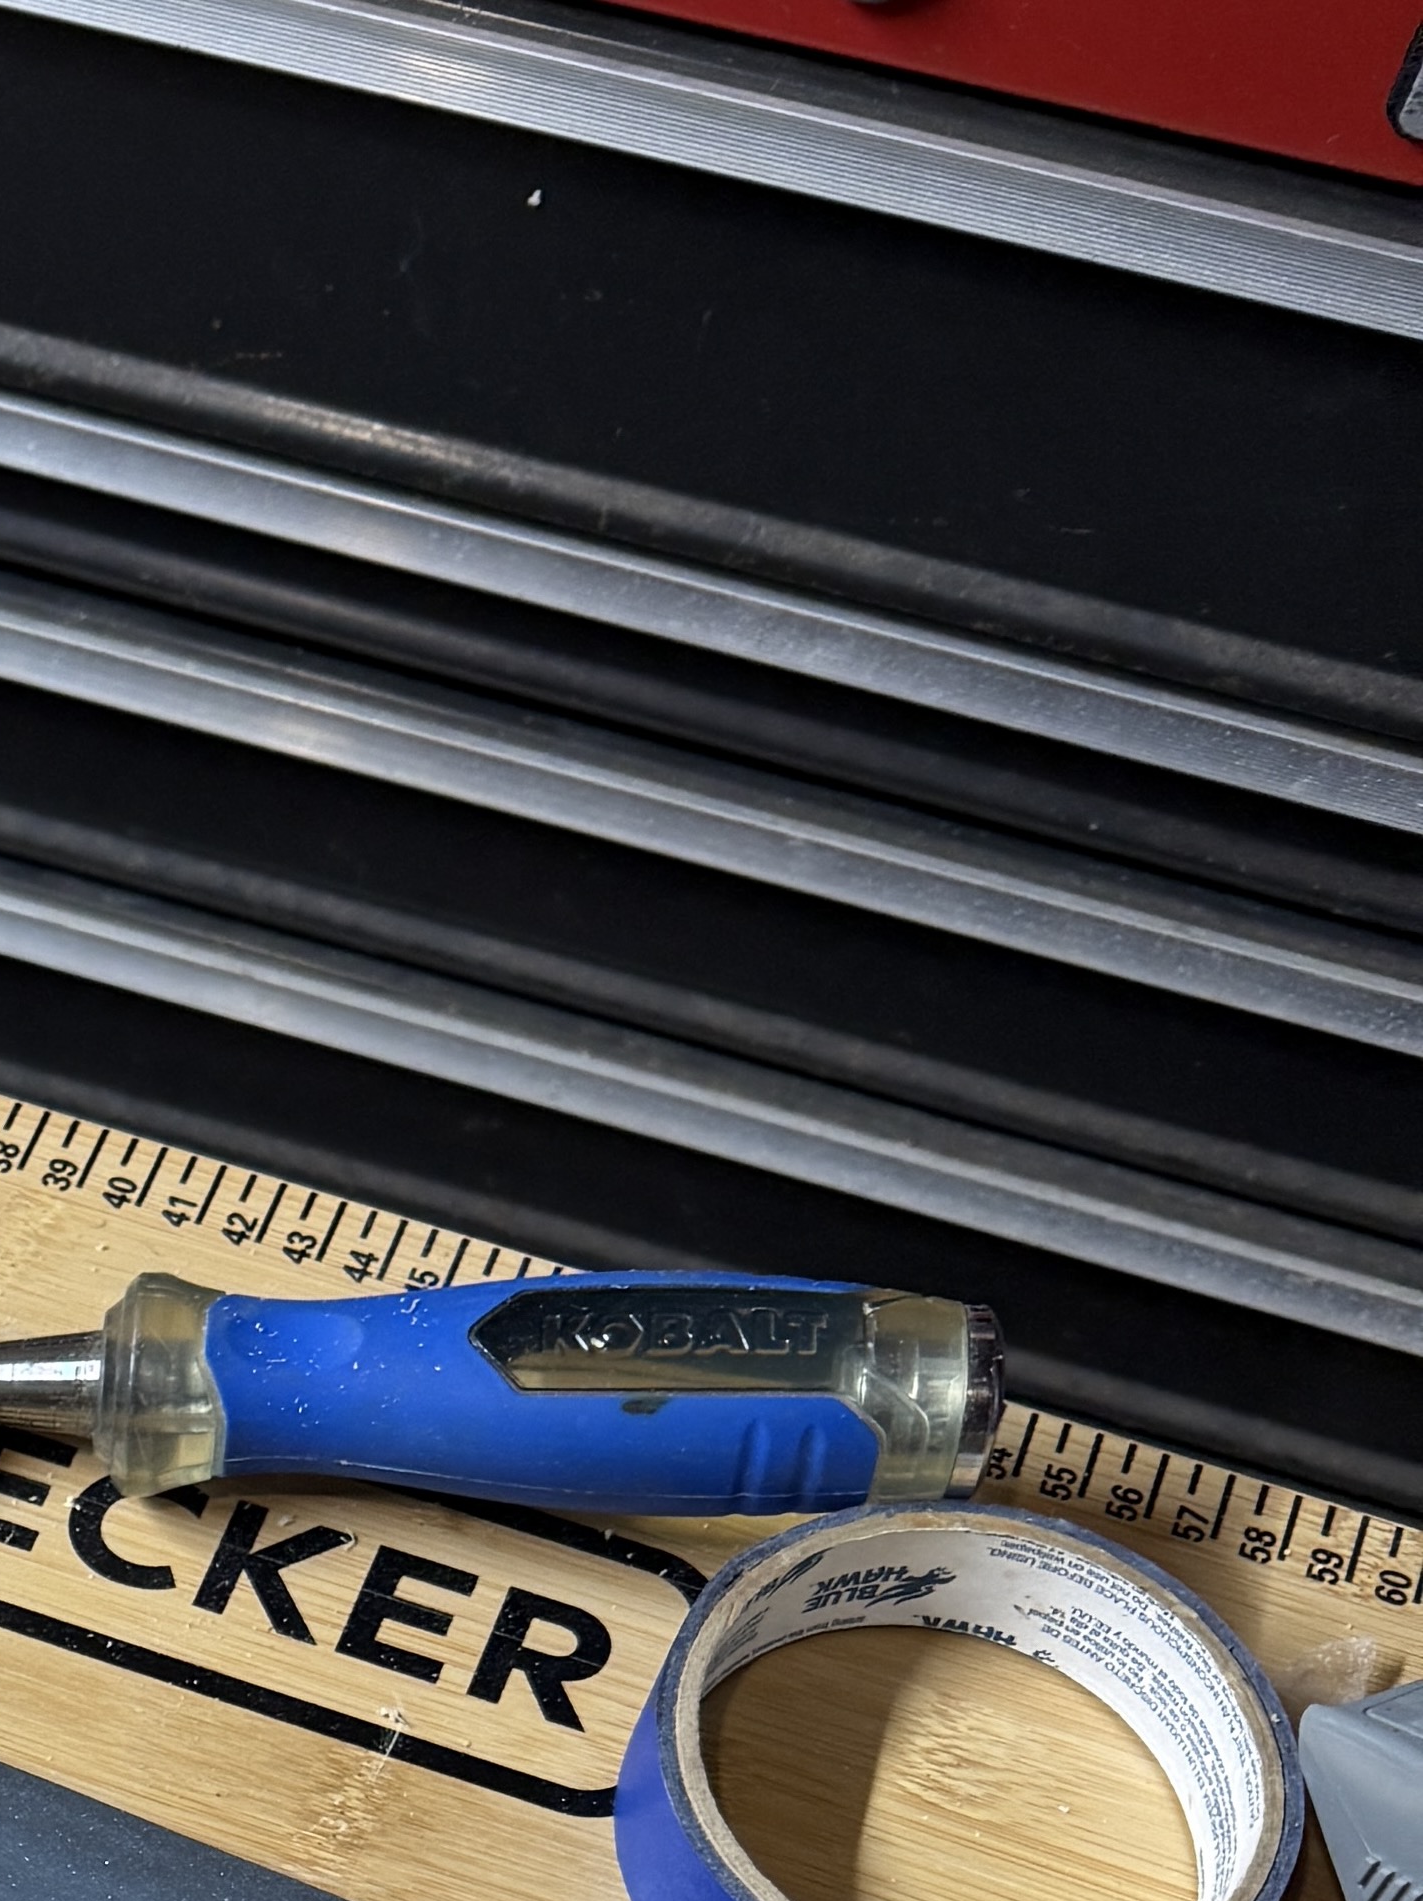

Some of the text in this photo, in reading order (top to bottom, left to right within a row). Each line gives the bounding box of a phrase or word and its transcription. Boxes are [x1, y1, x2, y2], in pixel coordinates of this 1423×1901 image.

[539, 1308, 829, 1358] KOBALT
[102, 1176, 138, 1210] 40
[1237, 1525, 1277, 1565] 58
[1374, 1569, 1413, 1606] 60
[801, 1584, 880, 1614] BLUE
[810, 1566, 910, 1594] HAWK
